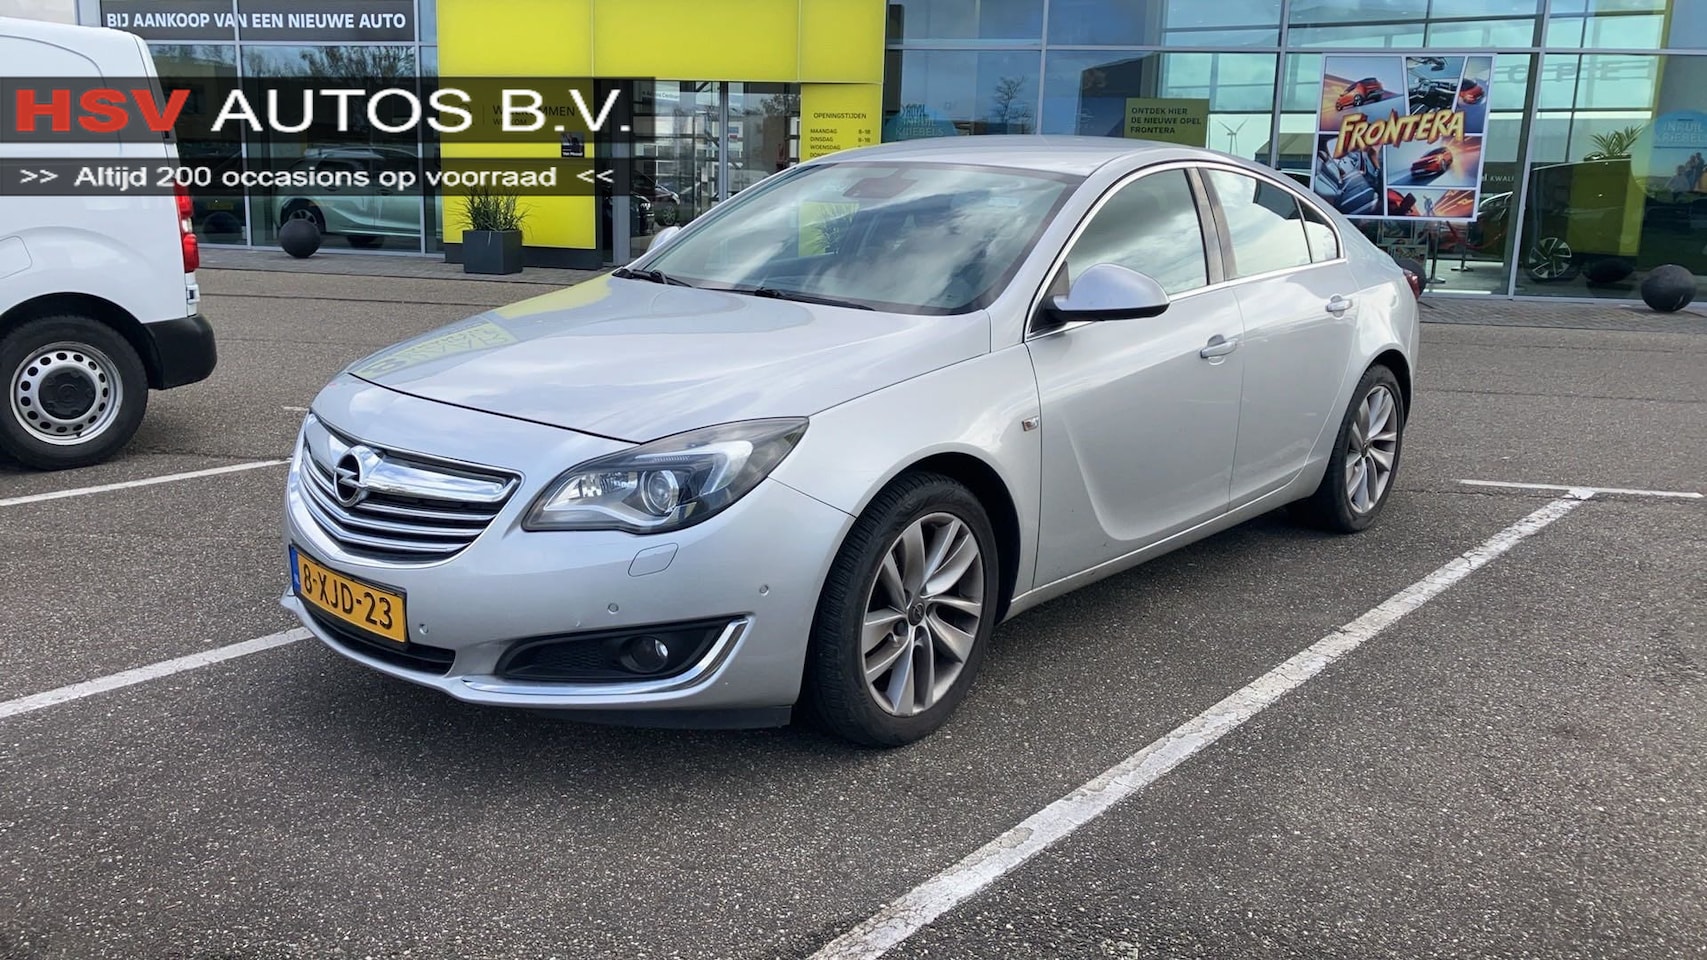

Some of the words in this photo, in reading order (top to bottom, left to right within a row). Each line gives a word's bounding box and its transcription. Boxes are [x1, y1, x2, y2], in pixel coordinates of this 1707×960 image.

[106, 13, 128, 28] BIJ
[133, 13, 210, 28] AANKOOP
[213, 13, 248, 28] VAN
[252, 13, 284, 28] EEN
[288, 13, 355, 29] NIEUWE
[358, 13, 406, 29] AUTO
[1131, 107, 1166, 115] ONTDEK
[1168, 107, 1188, 115] HIER
[1143, 117, 1177, 125] NIEUWE
[1180, 117, 1201, 125] OPEL
[1333, 108, 1466, 159] FRONTERA
[303, 562, 394, 631] 8-XJD-23
